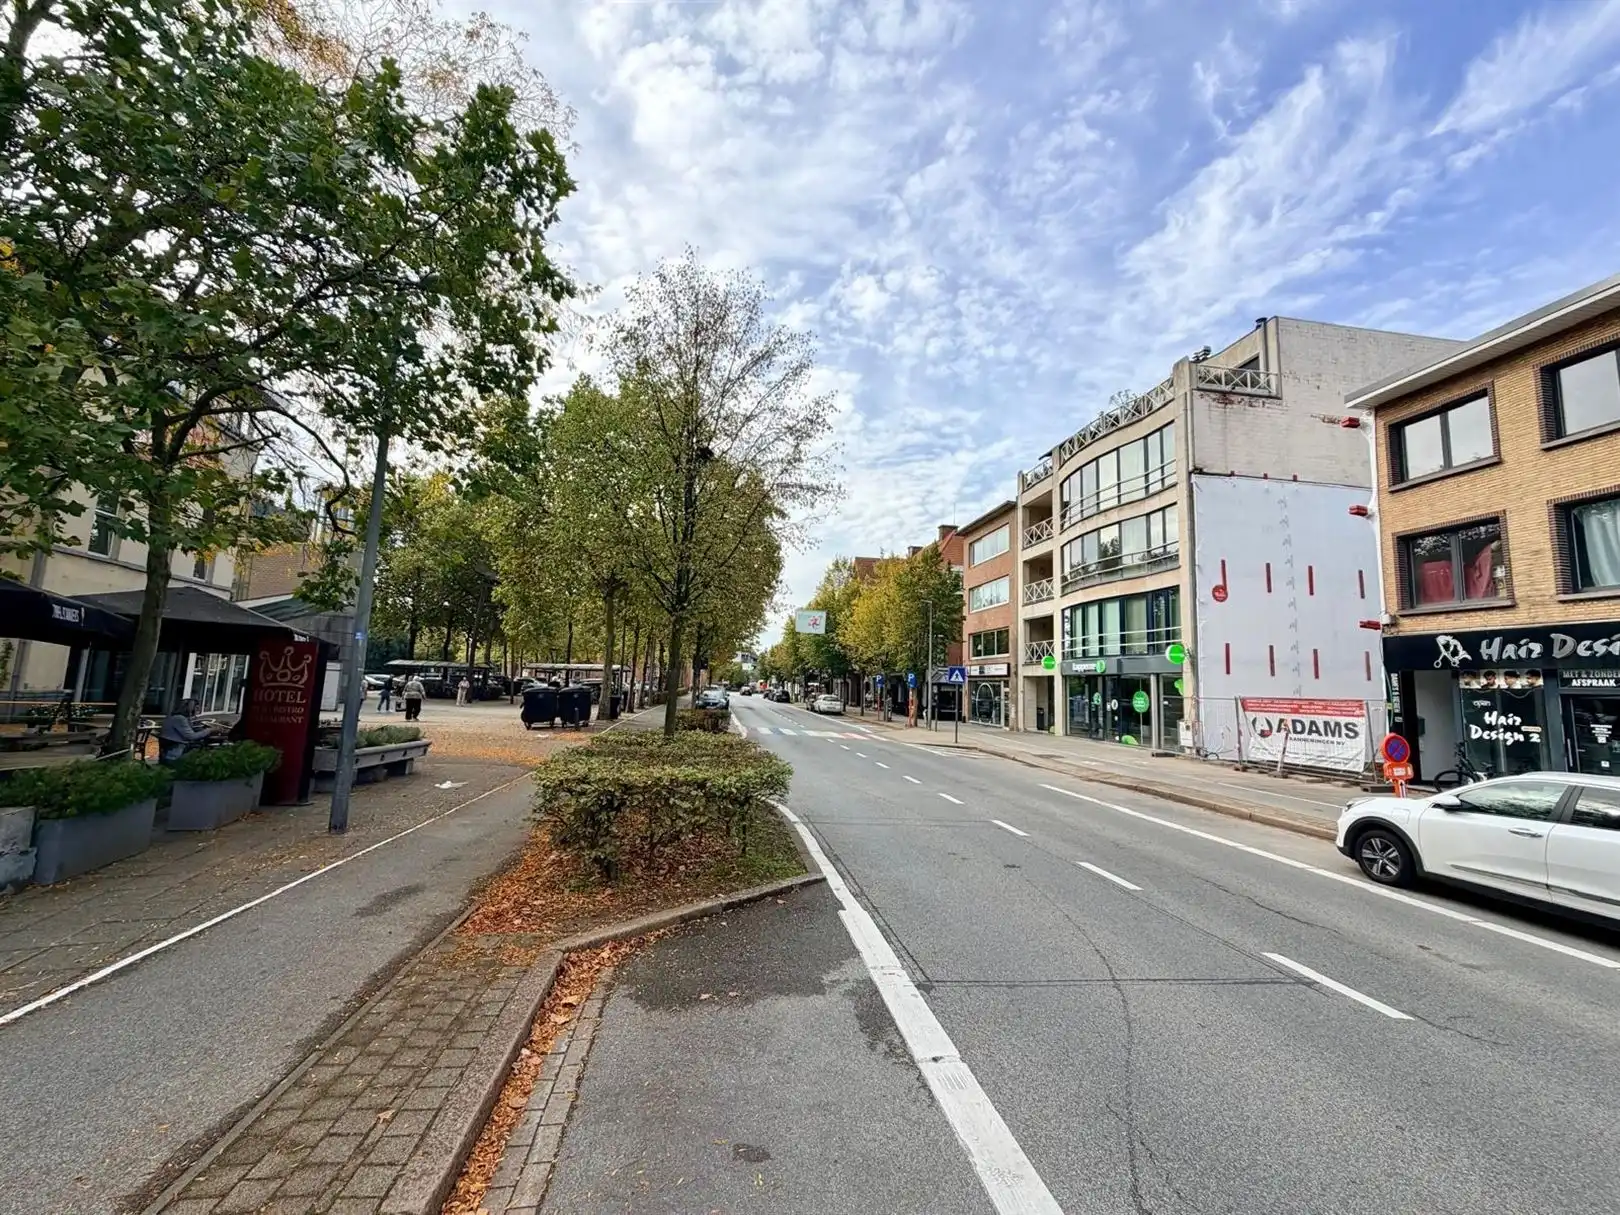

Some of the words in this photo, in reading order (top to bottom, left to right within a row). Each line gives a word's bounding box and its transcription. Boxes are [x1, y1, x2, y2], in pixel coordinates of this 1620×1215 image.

[1479, 636, 1543, 662] Hair
[1562, 670, 1579, 678] MET
[1571, 678, 1616, 687] AFSPRAAK
[253, 688, 306, 704] HOTEL
[1483, 710, 1522, 726] Hair
[1276, 717, 1360, 740] ADAMS
[1469, 724, 1525, 746] Design
[1529, 733, 1541, 743] 2
